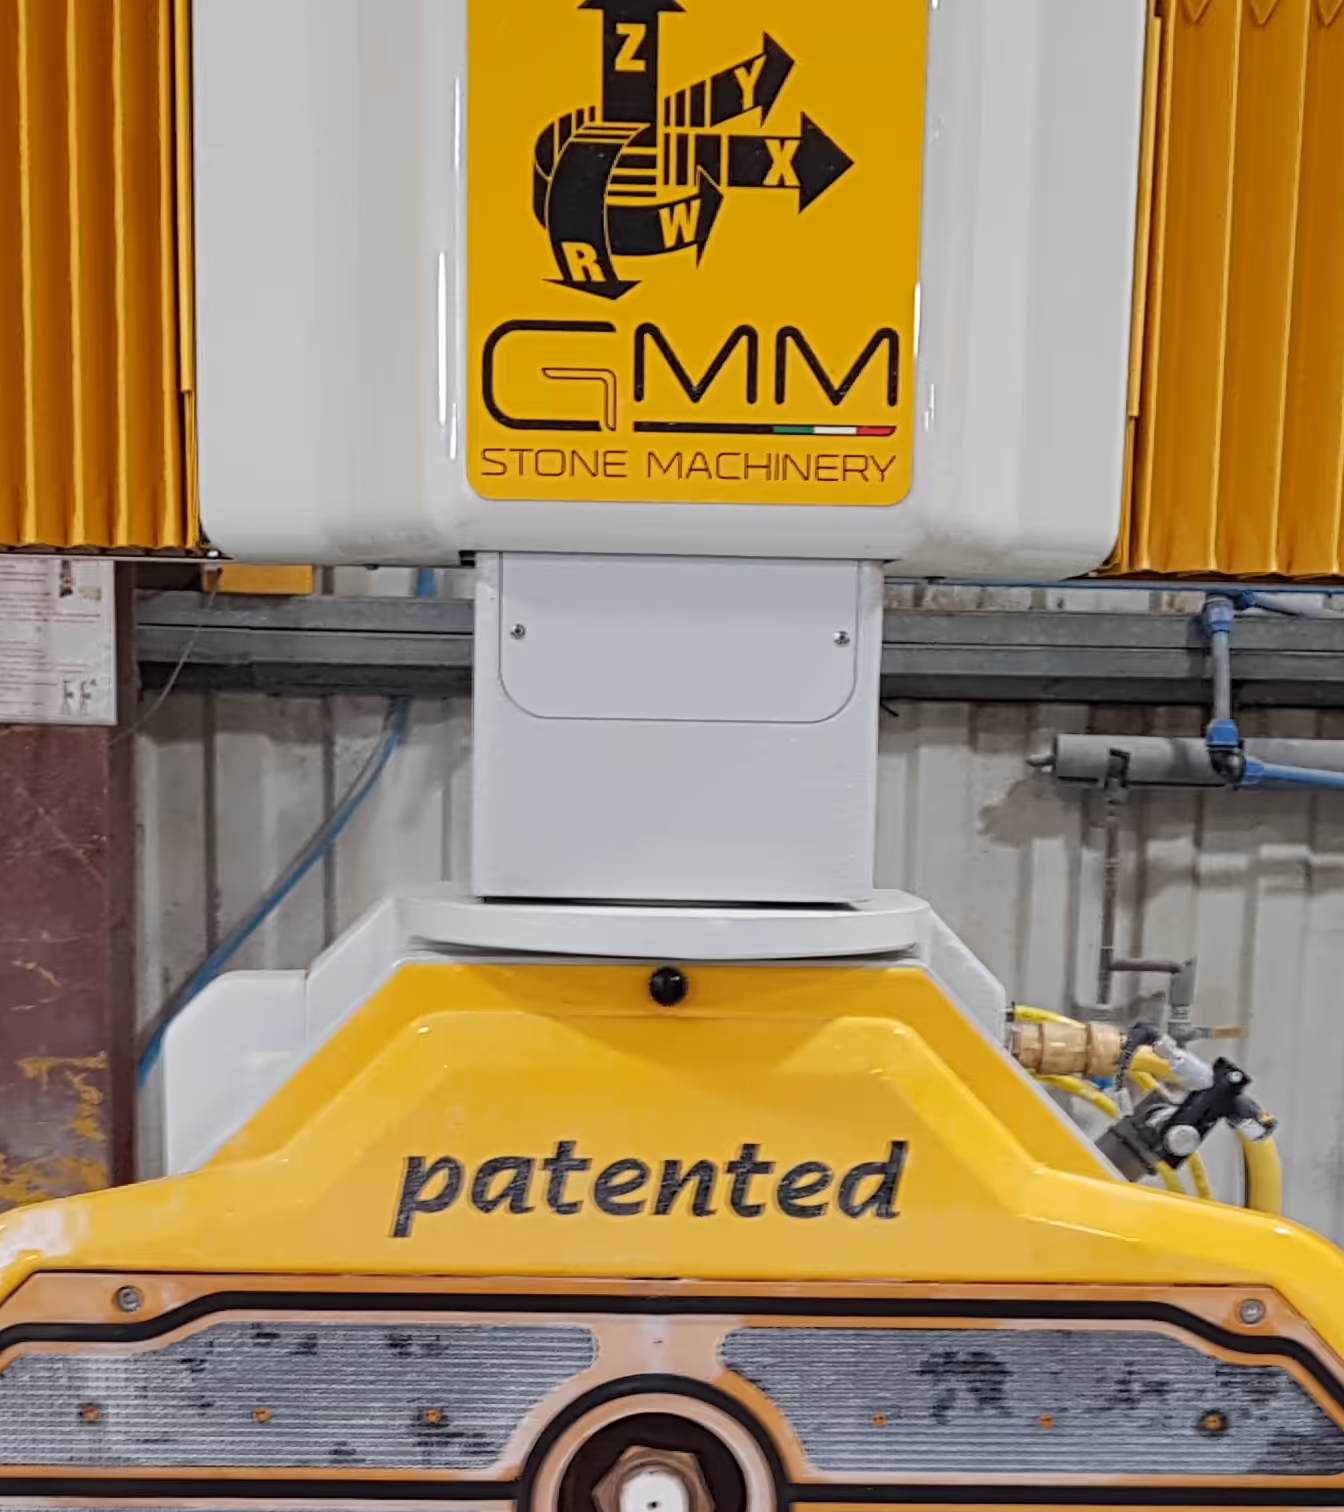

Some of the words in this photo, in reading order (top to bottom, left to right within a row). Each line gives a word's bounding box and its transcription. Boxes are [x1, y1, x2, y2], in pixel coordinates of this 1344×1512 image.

[614, 23, 647, 72] Z
[734, 55, 767, 110] Y
[763, 138, 800, 187] X
[658, 200, 702, 249] W
[561, 241, 608, 283] R
[482, 319, 900, 432] GMM
[481, 448, 628, 479] STONE
[647, 450, 897, 483] MACHINERY
[388, 1140, 909, 1238] patented
